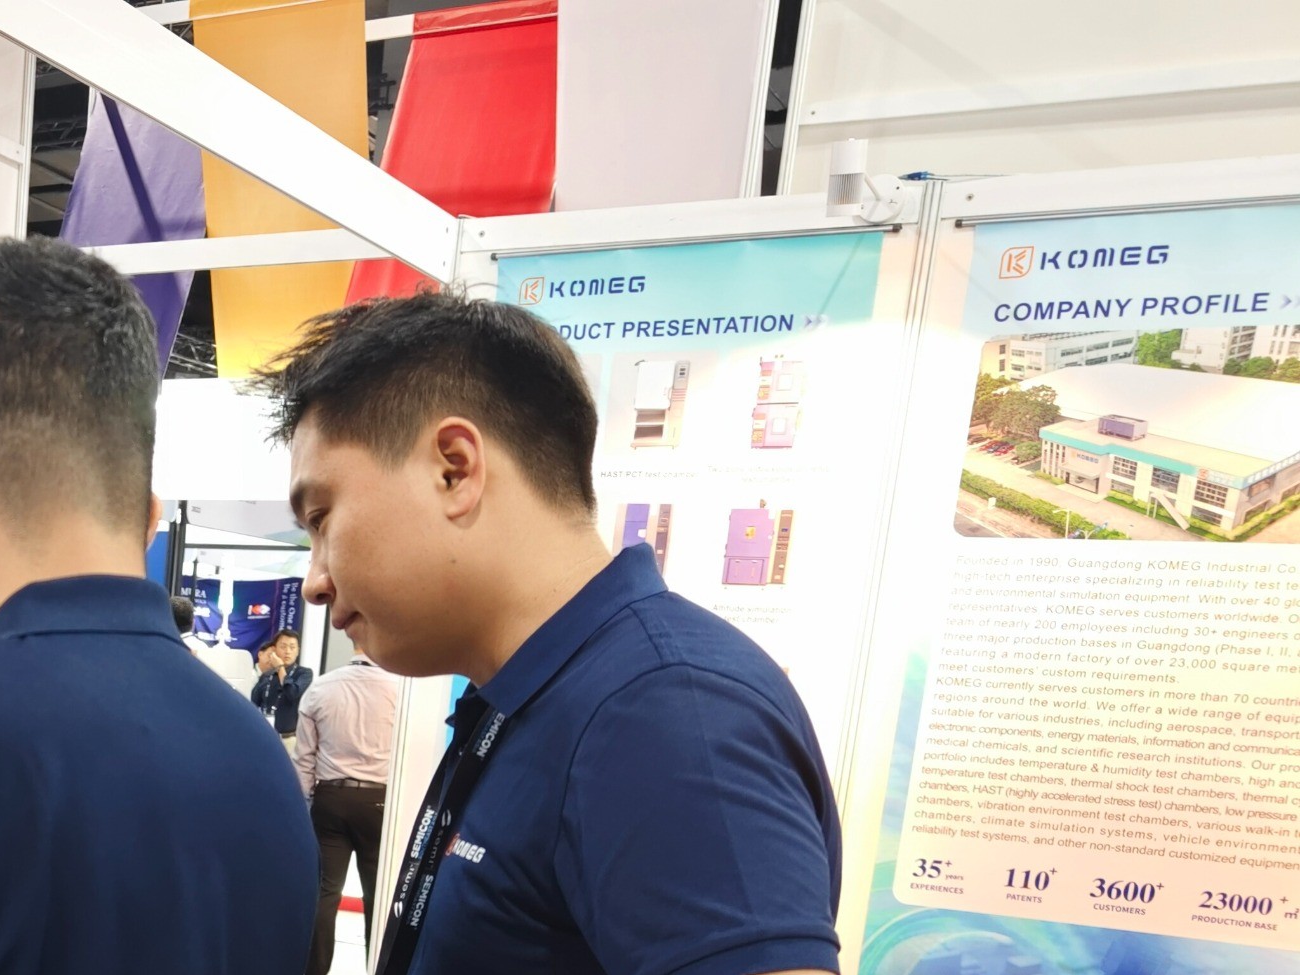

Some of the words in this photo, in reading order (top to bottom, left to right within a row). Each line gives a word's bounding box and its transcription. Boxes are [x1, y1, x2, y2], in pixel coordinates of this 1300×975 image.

[1040, 244, 1170, 271] KOMEG
[549, 275, 646, 299] KOMEG
[993, 298, 1132, 322] COMPANY
[1140, 292, 1270, 317] PROFILE
[559, 322, 616, 342] DUCT
[621, 312, 795, 338] PRESENTATION
[476, 712, 506, 758] EMICON
[929, 722, 976, 733] electronic
[979, 726, 1043, 738] components,
[1048, 730, 1084, 742] energy
[1088, 733, 1139, 745] materials,
[1143, 736, 1204, 749] information
[1208, 742, 1230, 751] and
[931, 708, 974, 717] suitable
[979, 710, 994, 718] for
[998, 712, 1039, 722] various
[1108, 718, 1162, 732] including
[1167, 723, 1236, 736] aerospace,
[926, 737, 968, 747] medical
[972, 740, 1031, 752] chemicals,
[1035, 745, 1057, 754] and
[1061, 747, 1113, 758] scientific
[1117, 750, 1170, 762] research
[1175, 754, 1245, 768] institutions.
[1251, 759, 1275, 771] Our
[921, 766, 984, 779] temperature
[988, 769, 1007, 780] test
[1010, 772, 1066, 786] chambers,
[1071, 778, 1112, 789] thermal
[1116, 782, 1149, 792] shock
[1153, 784, 1173, 795] test
[1177, 786, 1238, 800] chambers,
[1243, 793, 1288, 804] thermal
[923, 752, 966, 762] portfolio
[970, 755, 1015, 766] includes
[1019, 759, 1087, 772] temperature
[1091, 763, 1099, 772] &
[1103, 765, 1151, 779] humidity
[1156, 769, 1177, 779] test
[1181, 771, 1243, 785] chambers,
[1249, 776, 1275, 788] high
[917, 795, 972, 808] chambers,
[978, 800, 1025, 812] vibration
[1029, 805, 1100, 819] environment
[1104, 812, 1125, 821] test
[1129, 814, 1192, 829] chambers,
[1197, 820, 1241, 832] various
[1245, 824, 1290, 837] walk-in
[919, 781, 969, 794] chambers,
[973, 785, 1004, 795] HAST
[1006, 786, 1039, 800] (highly
[1041, 792, 1101, 804] accelerated
[1104, 796, 1135, 807] stress
[1139, 799, 1162, 810] test)
[1165, 801, 1222, 815] chambers,
[1225, 806, 1244, 816] low
[1247, 808, 1297, 822] pressure
[914, 810, 975, 823] chambers,
[981, 816, 1025, 827] climate
[1030, 820, 1095, 834] simulation
[1100, 827, 1157, 841] systems,
[1163, 833, 1210, 845] vehicle
[912, 825, 957, 837] reliability
[960, 828, 980, 838] test
[982, 831, 1030, 844] systems,
[1034, 835, 1054, 845] and
[1058, 838, 1087, 848] other
[1090, 842, 1165, 856] non-standard
[1169, 850, 1236, 864] customized
[910, 882, 964, 894] EXPERIENCES
[1006, 893, 1042, 903] PATENTS
[1093, 903, 1146, 915] CUSTOMERS
[1191, 915, 1252, 928] PRODUCTION
[1254, 922, 1277, 931] BASE
